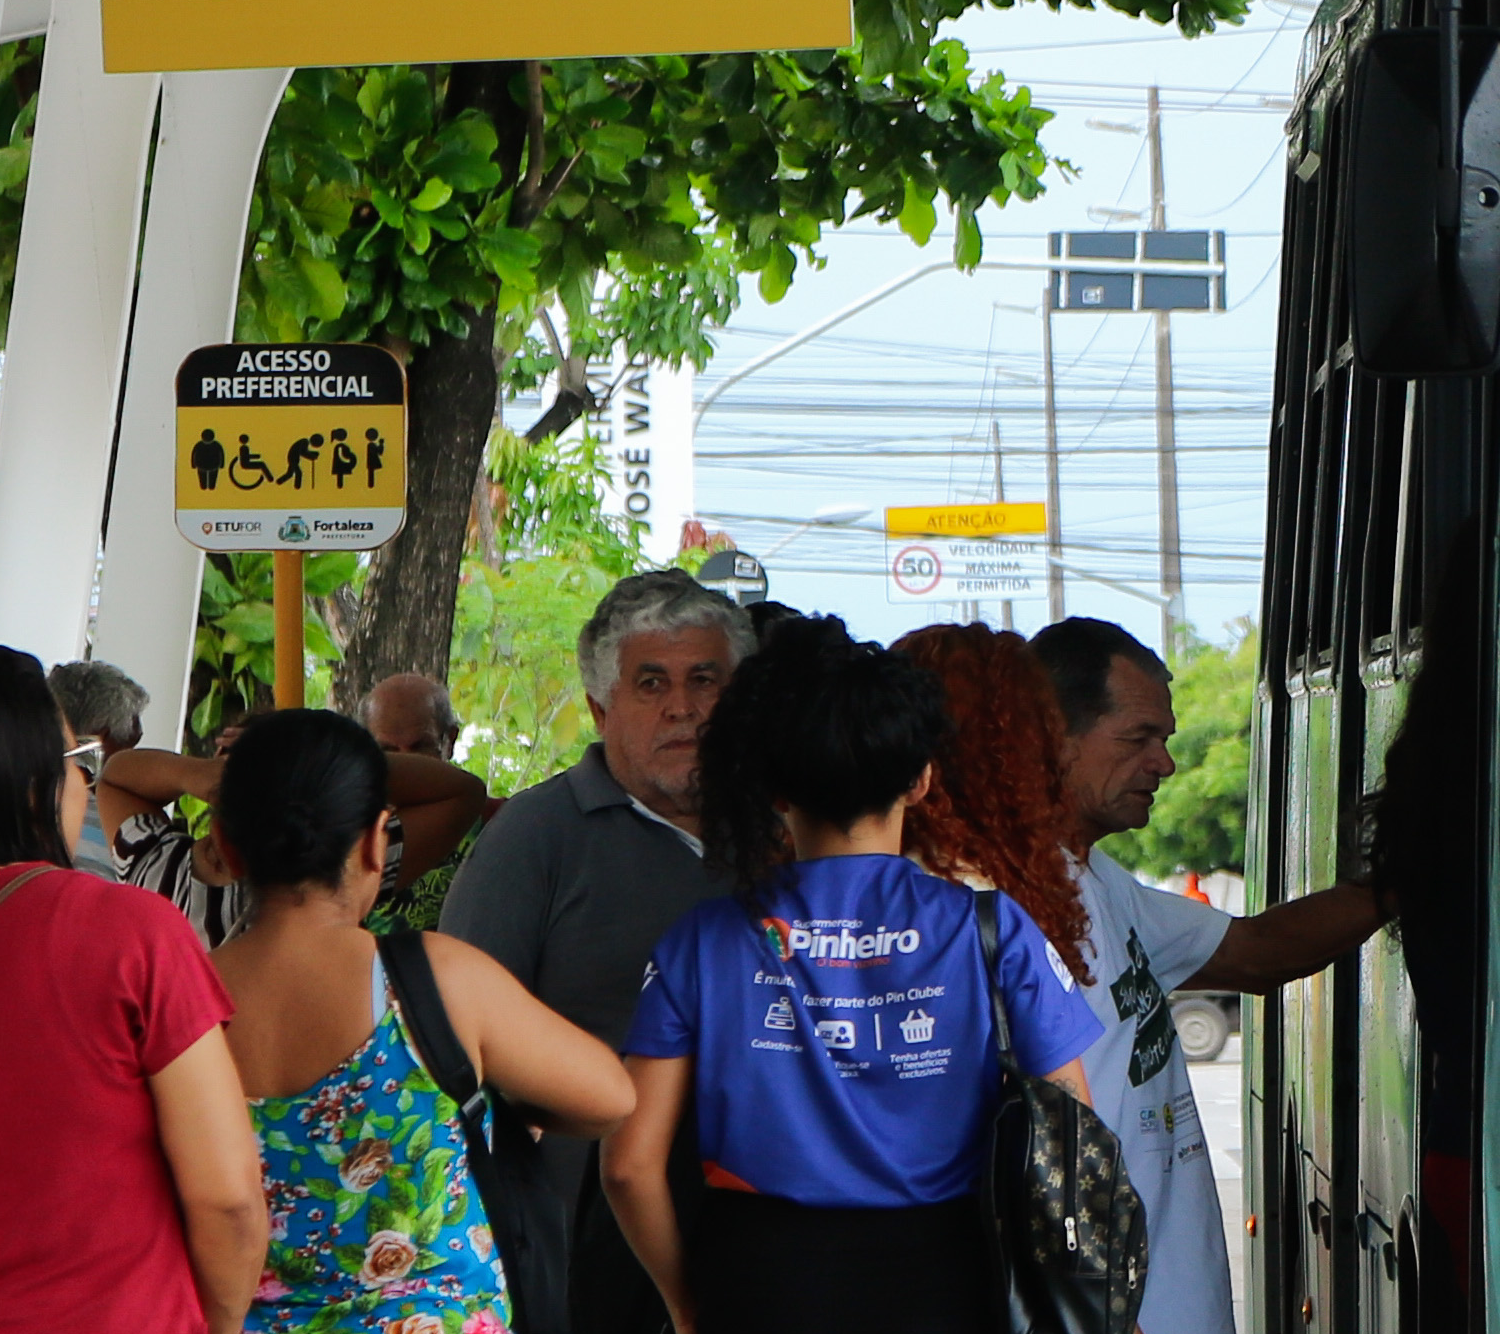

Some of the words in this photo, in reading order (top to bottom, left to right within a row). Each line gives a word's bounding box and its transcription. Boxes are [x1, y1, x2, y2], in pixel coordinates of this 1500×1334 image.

[236, 350, 331, 373] ACESSO
[201, 375, 374, 399] PREFERENCIAL
[215, 522, 261, 532] ETUFOR
[313, 520, 374, 532] Fortaleza
[926, 511, 1006, 530] ATENÇÃO
[948, 543, 1034, 556] VELOCIDADE
[902, 557, 934, 577] 50
[957, 578, 1031, 593] PERMITIDA
[793, 919, 863, 929] Supermercado
[789, 926, 920, 960] Pinheiro
[754, 970, 764, 984] É
[802, 994, 831, 1007] fazer
[834, 995, 865, 1008] parte
[867, 995, 883, 1007] do
[886, 991, 905, 1003] Pin
[890, 1053, 918, 1063] Tenha
[920, 1048, 951, 1060] ofertas
